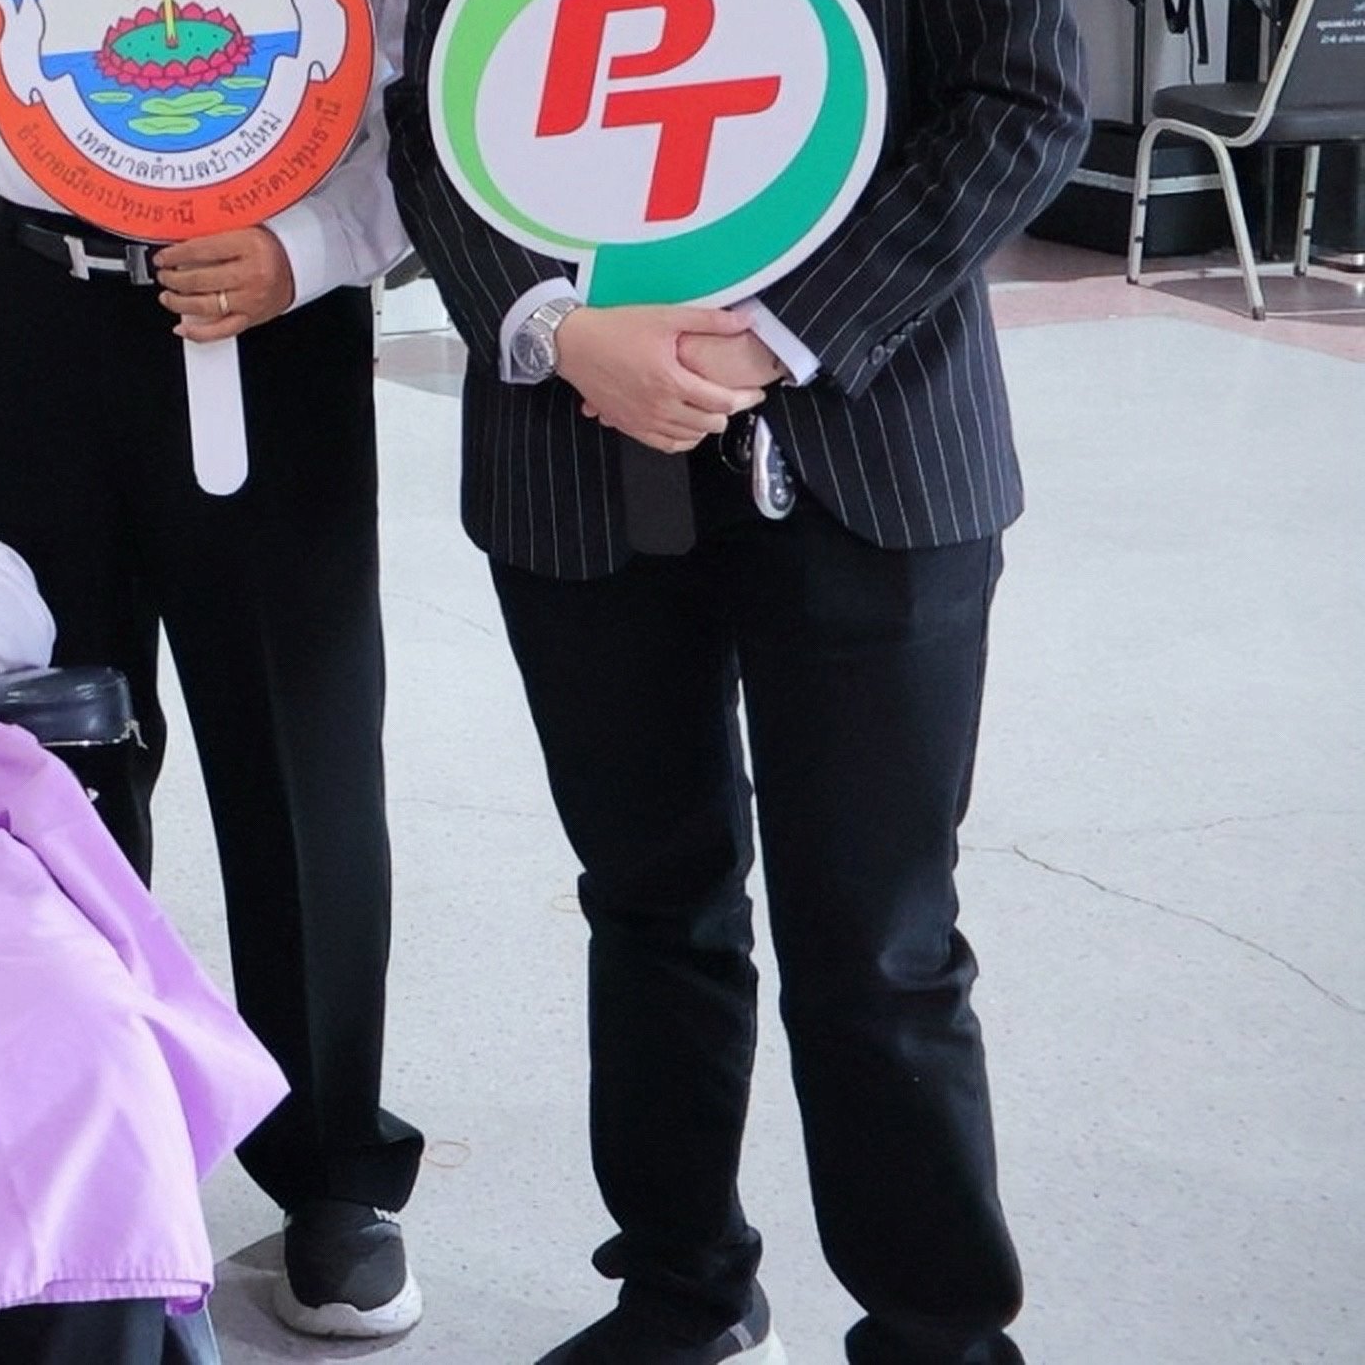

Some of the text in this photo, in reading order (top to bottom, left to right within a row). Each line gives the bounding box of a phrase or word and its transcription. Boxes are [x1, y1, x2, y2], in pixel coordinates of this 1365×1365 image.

[75, 109, 282, 183] เทศบาลตำบลบ้านใหม่
